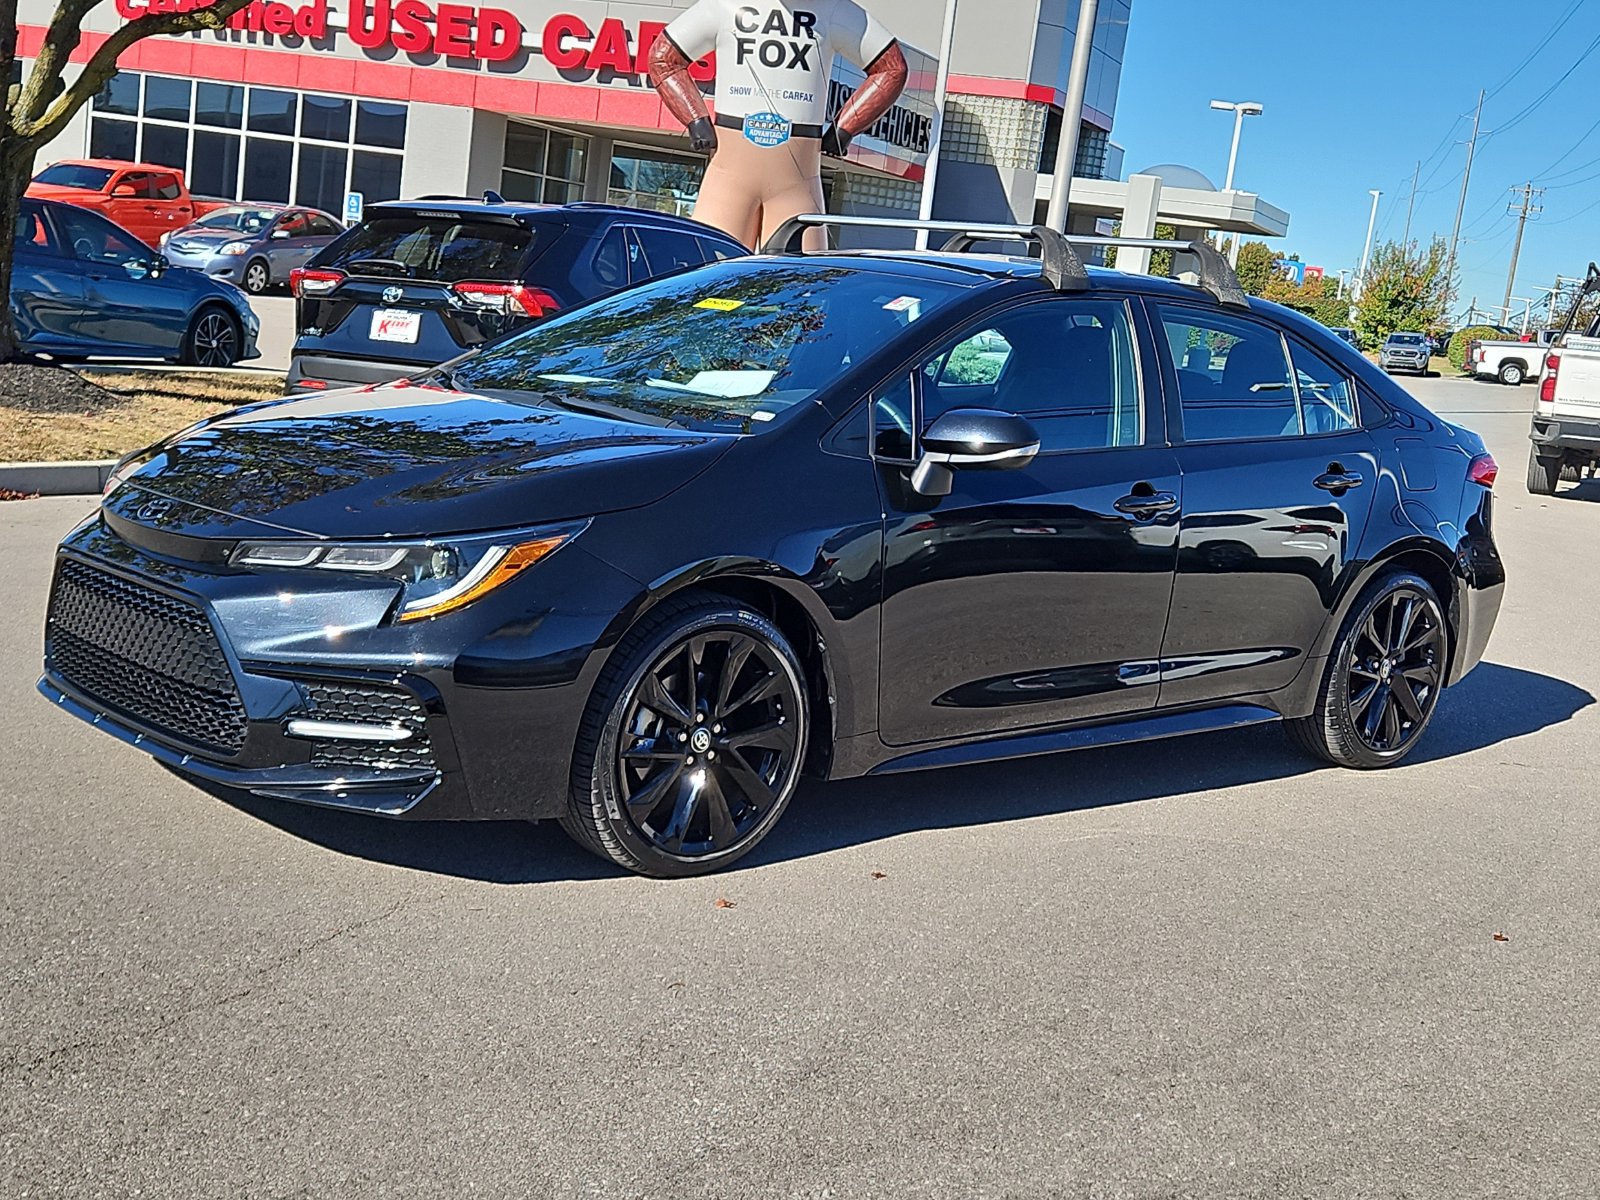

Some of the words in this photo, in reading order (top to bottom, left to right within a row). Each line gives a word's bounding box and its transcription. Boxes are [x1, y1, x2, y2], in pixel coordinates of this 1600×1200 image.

[348, 0, 523, 61] USED
[735, 6, 817, 40] CAR
[736, 37, 812, 72] FOX
[729, 85, 751, 96] SHOW
[768, 89, 781, 99] THE
[782, 90, 814, 102] CARFAX
